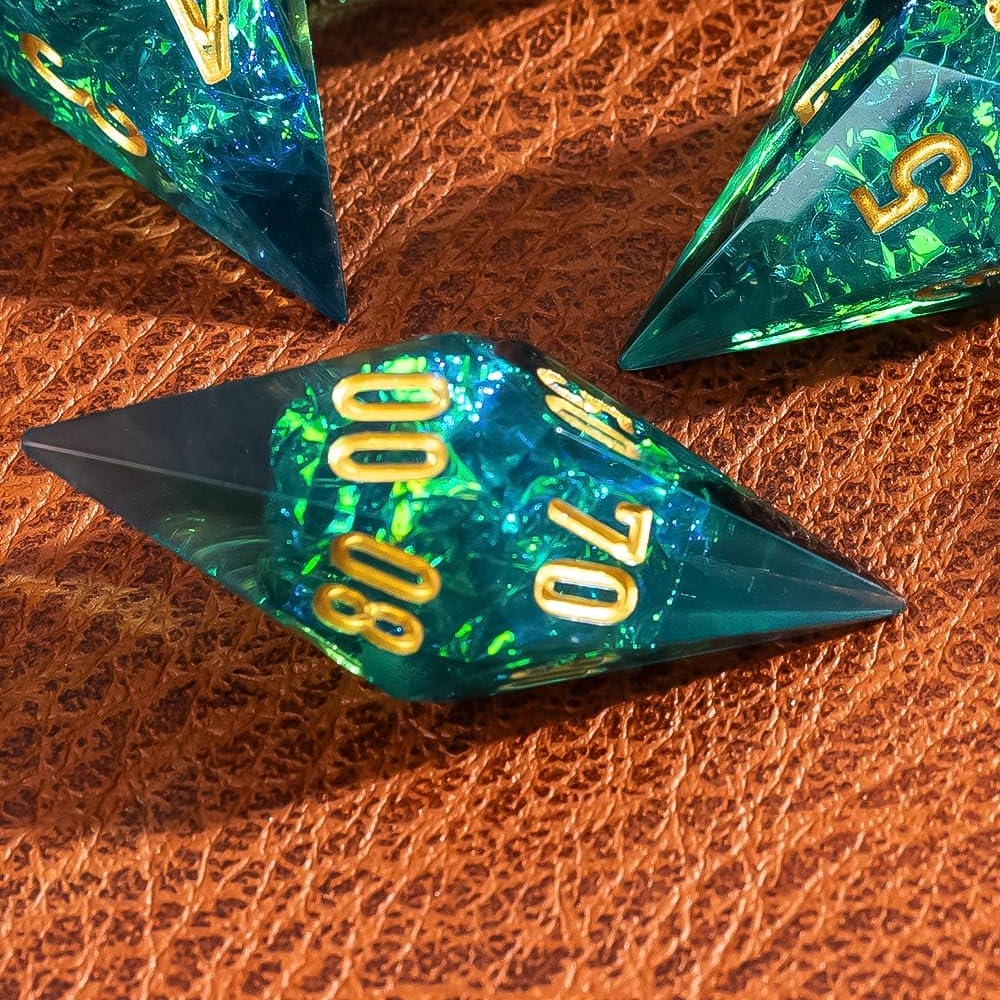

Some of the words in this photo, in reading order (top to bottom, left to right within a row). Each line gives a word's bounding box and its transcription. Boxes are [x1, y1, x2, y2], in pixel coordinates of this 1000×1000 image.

[18, 32, 148, 158] 3
[850, 132, 974, 235] 5
[328, 373, 451, 484] 00
[312, 531, 442, 656] 80
[533, 497, 654, 628] 70
